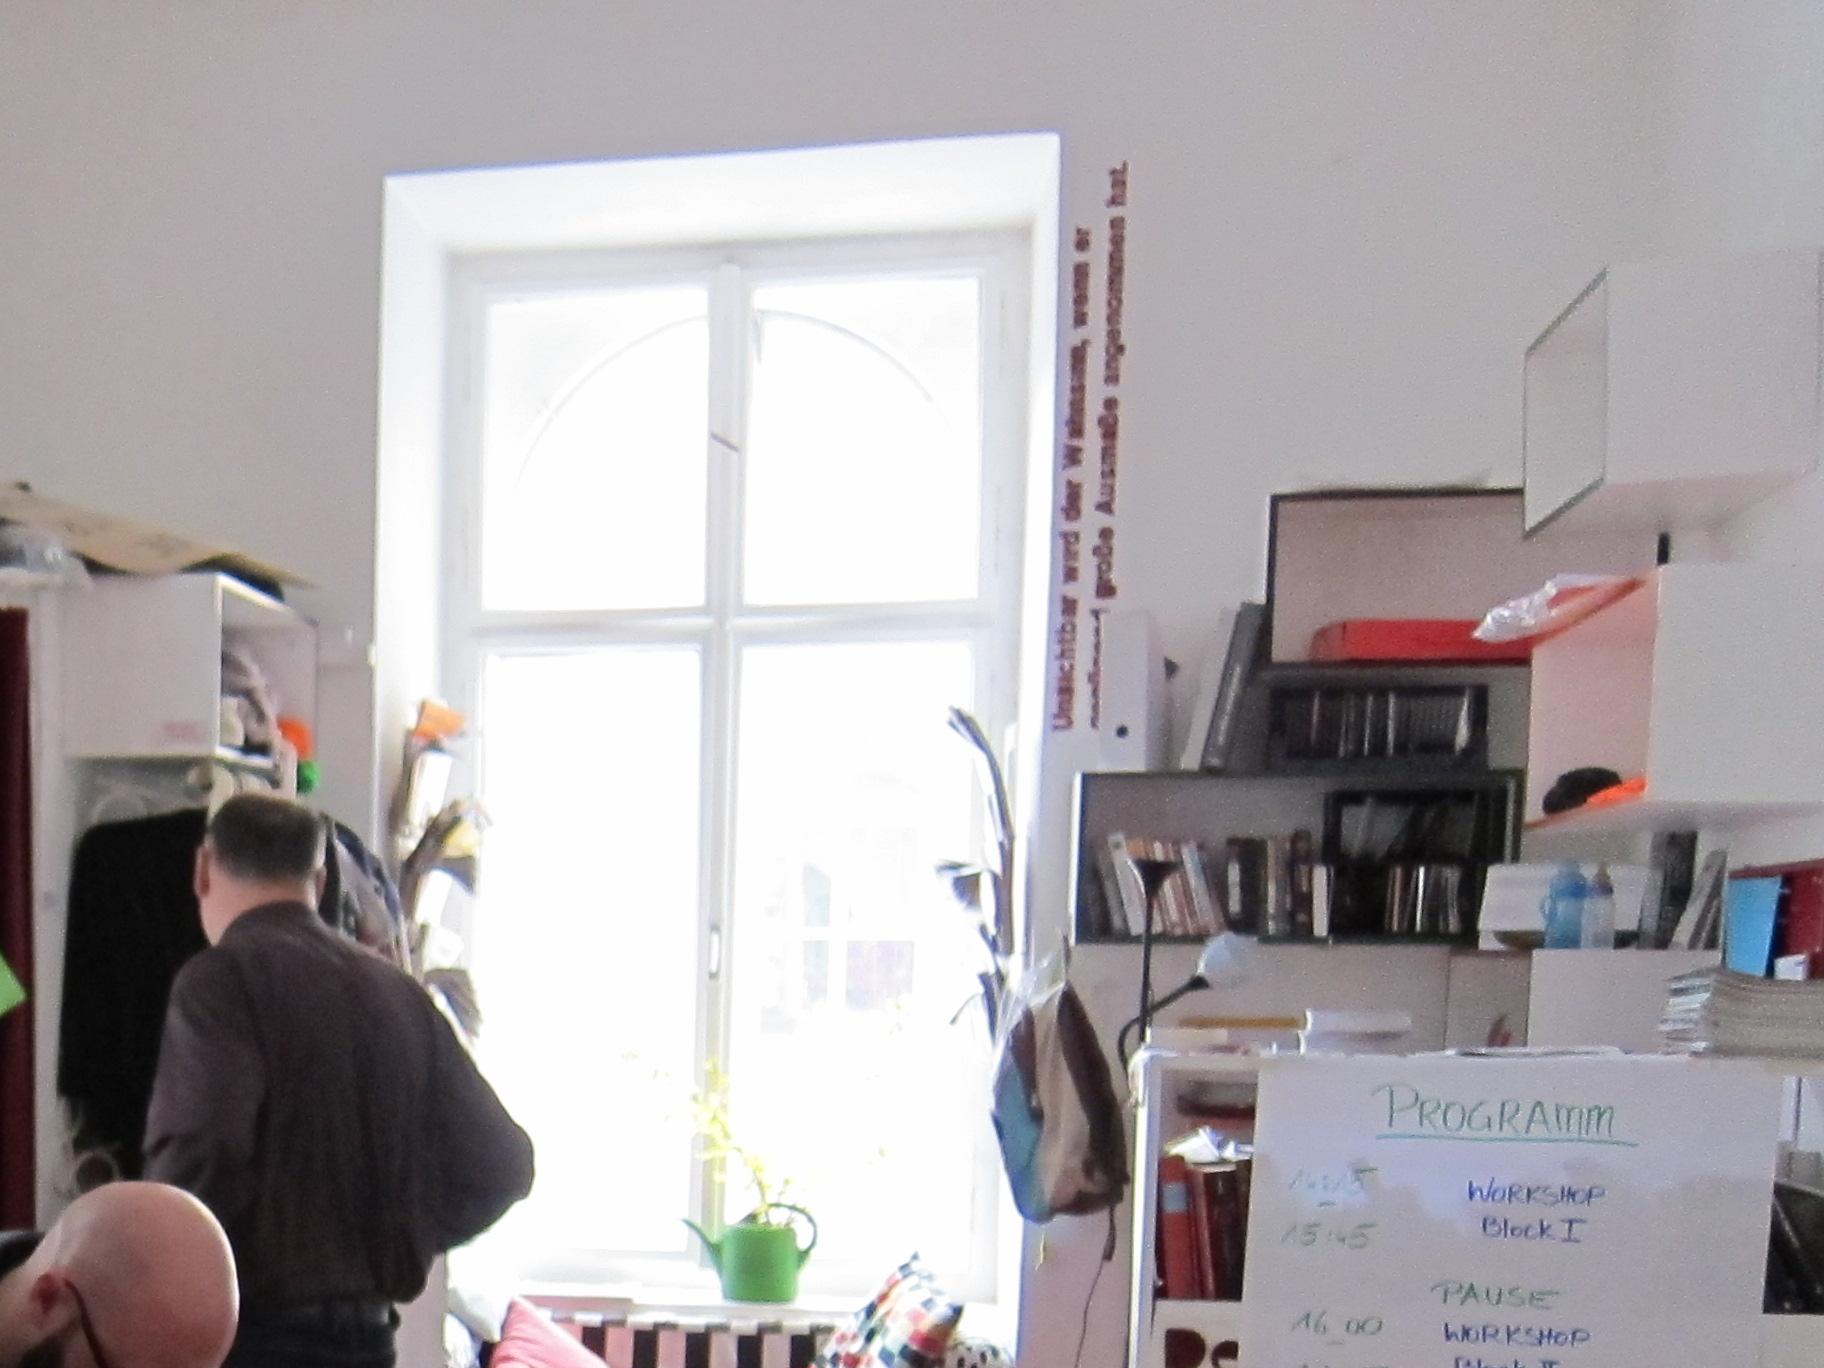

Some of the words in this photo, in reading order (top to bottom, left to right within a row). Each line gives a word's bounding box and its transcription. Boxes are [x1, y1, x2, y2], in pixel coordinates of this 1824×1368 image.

[1074, 226, 1090, 252] er
[1073, 262, 1090, 329] wenn
[1104, 215, 1126, 386] angenommen
[1095, 397, 1118, 515] Ausmaße
[1060, 479, 1082, 522] der
[1059, 531, 1080, 585] wird
[1092, 527, 1117, 599] große
[1053, 595, 1079, 730] Unsichtbar
[1482, 1216, 1553, 1240] Block
[1431, 1280, 1560, 1310] PAUSE
